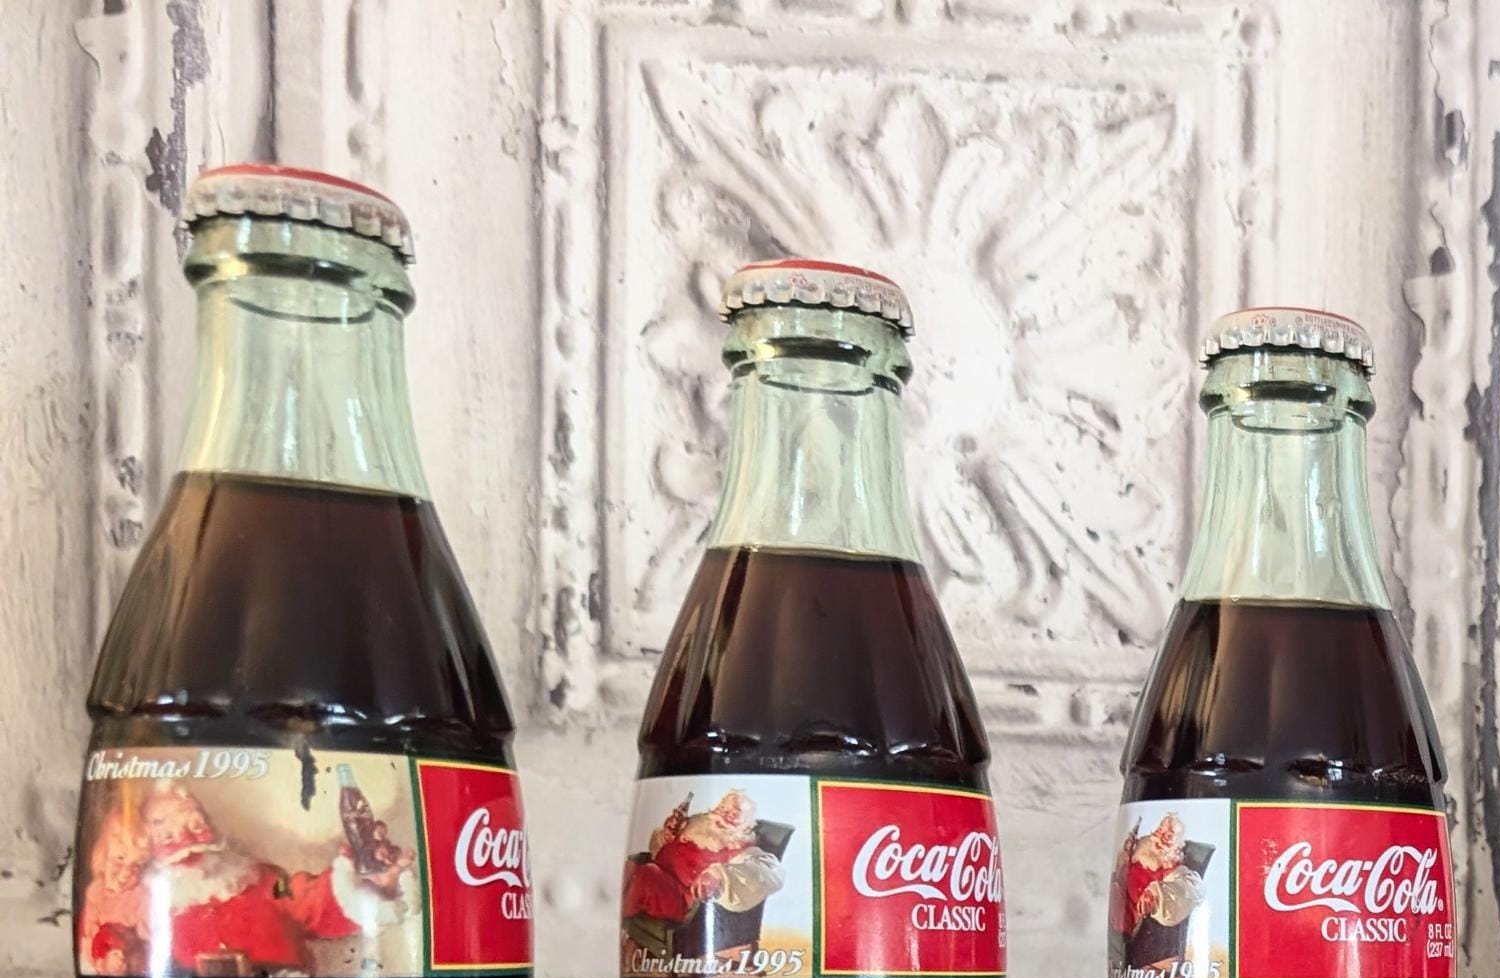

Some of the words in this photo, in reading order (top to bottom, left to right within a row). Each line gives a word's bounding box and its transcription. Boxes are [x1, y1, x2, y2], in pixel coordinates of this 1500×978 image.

[86, 752, 190, 782] Christmas
[194, 750, 271, 780] 1995
[852, 824, 1002, 903] Coca-Cola
[911, 903, 986, 932] CLASSIC
[1321, 916, 1407, 943] CLASSIC
[1427, 923, 1434, 939] 8
[631, 947, 731, 977] Christmas
[734, 948, 808, 977] 1995
